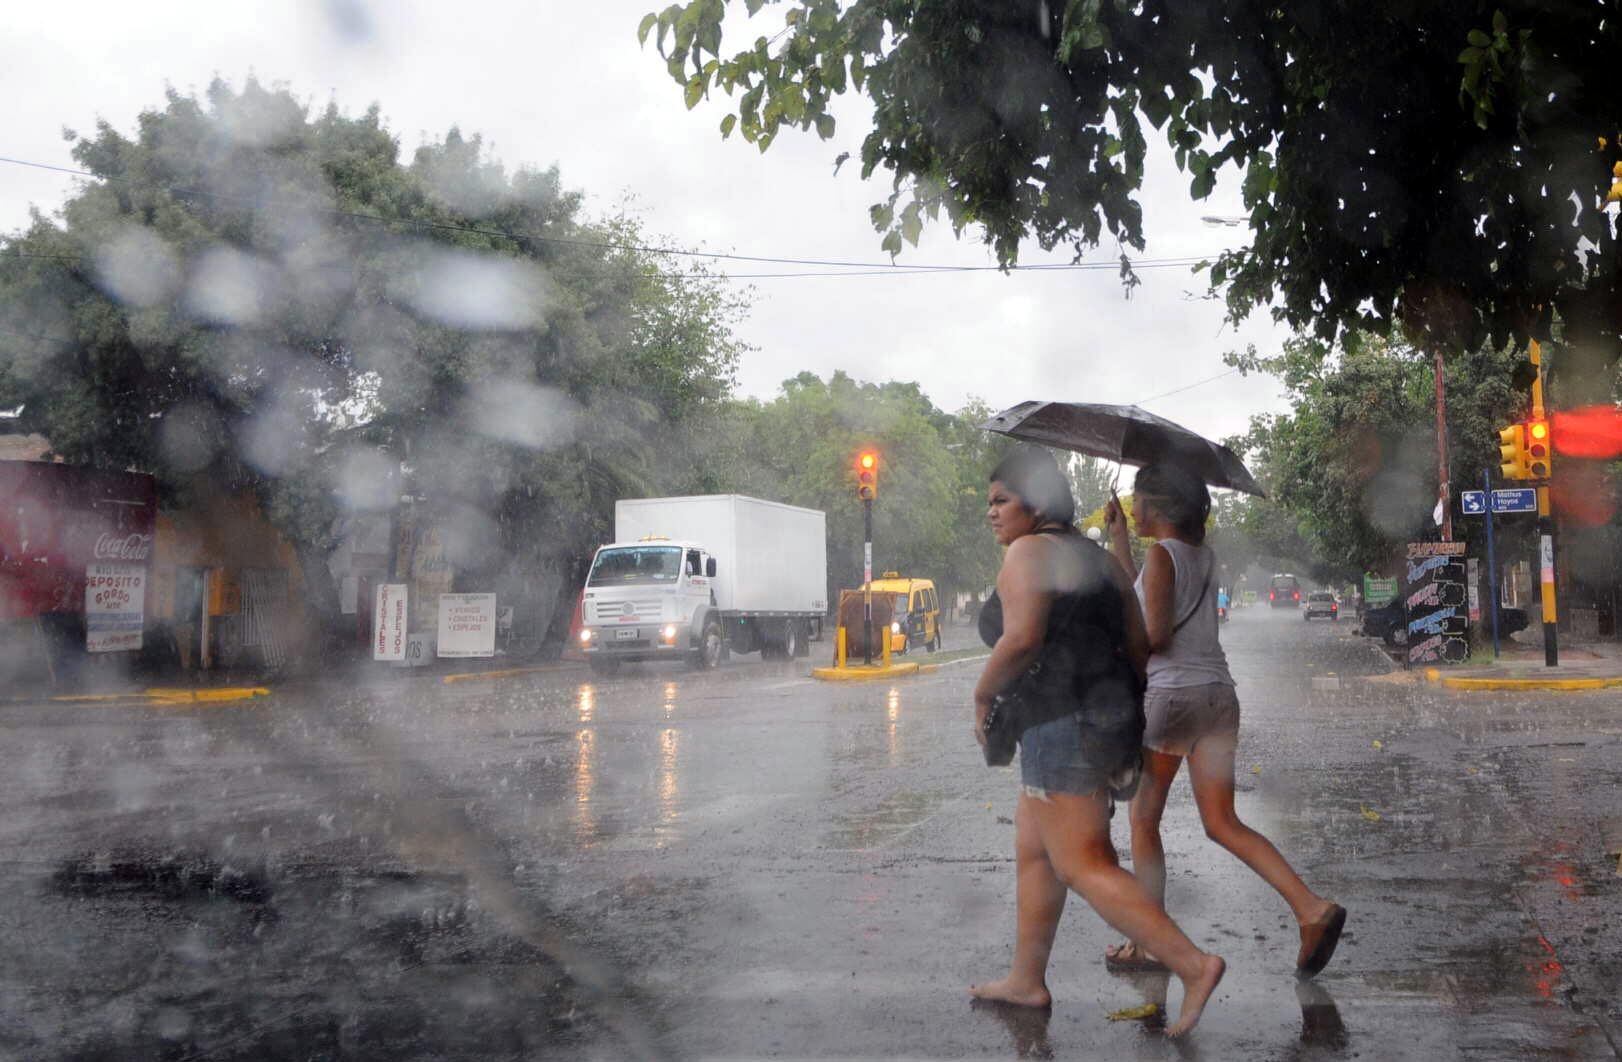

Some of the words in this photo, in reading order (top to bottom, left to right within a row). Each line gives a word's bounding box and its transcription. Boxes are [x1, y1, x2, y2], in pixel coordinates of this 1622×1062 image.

[1497, 498, 1519, 506] Hoyos
[95, 588, 129, 604] GORDO
[378, 585, 388, 655] CRISTALES
[394, 600, 404, 655] ESPEJOS
